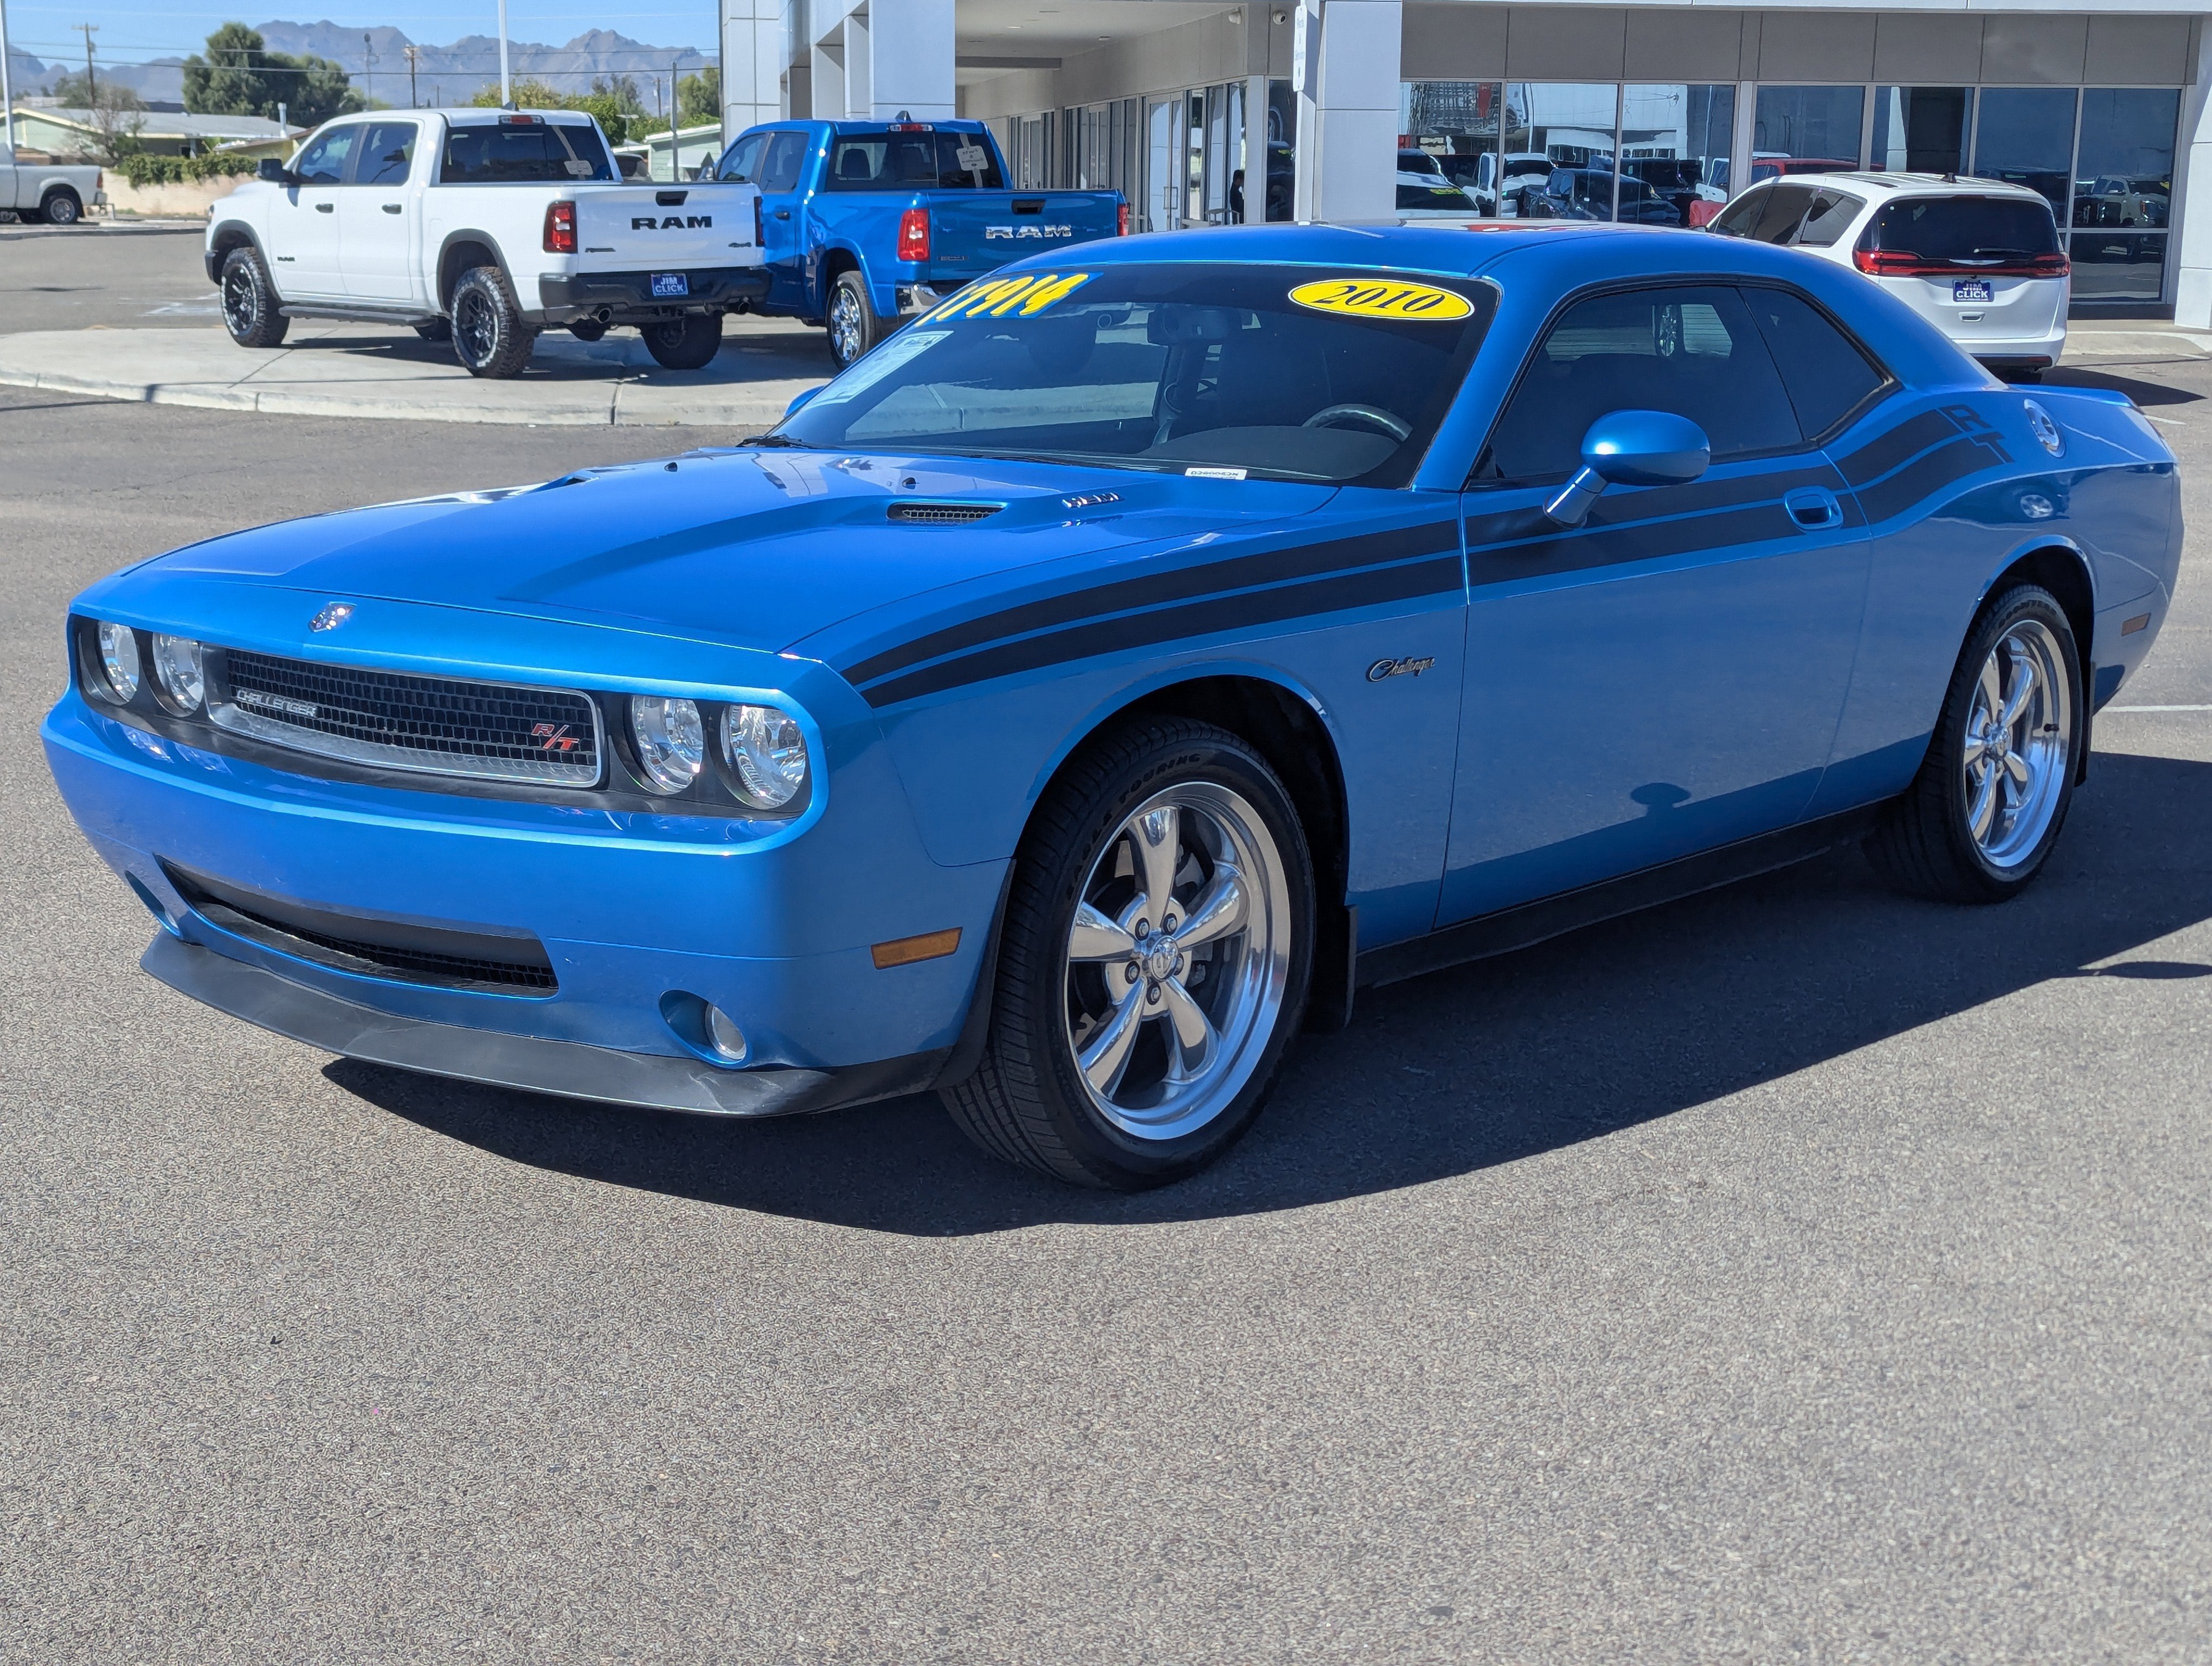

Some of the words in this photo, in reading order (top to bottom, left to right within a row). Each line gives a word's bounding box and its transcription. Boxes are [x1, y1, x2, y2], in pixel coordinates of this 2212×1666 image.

[632, 216, 712, 230] RAM
[985, 225, 1072, 239] RAM
[655, 285, 684, 293] CLICK
[1310, 285, 1445, 312] 2010
[1956, 290, 1989, 298] CLICK
[1366, 657, 1436, 682] Challenger
[236, 689, 318, 718] CHALLENGER
[531, 723, 580, 751] R/T
[1118, 753, 1201, 804] TOURING
